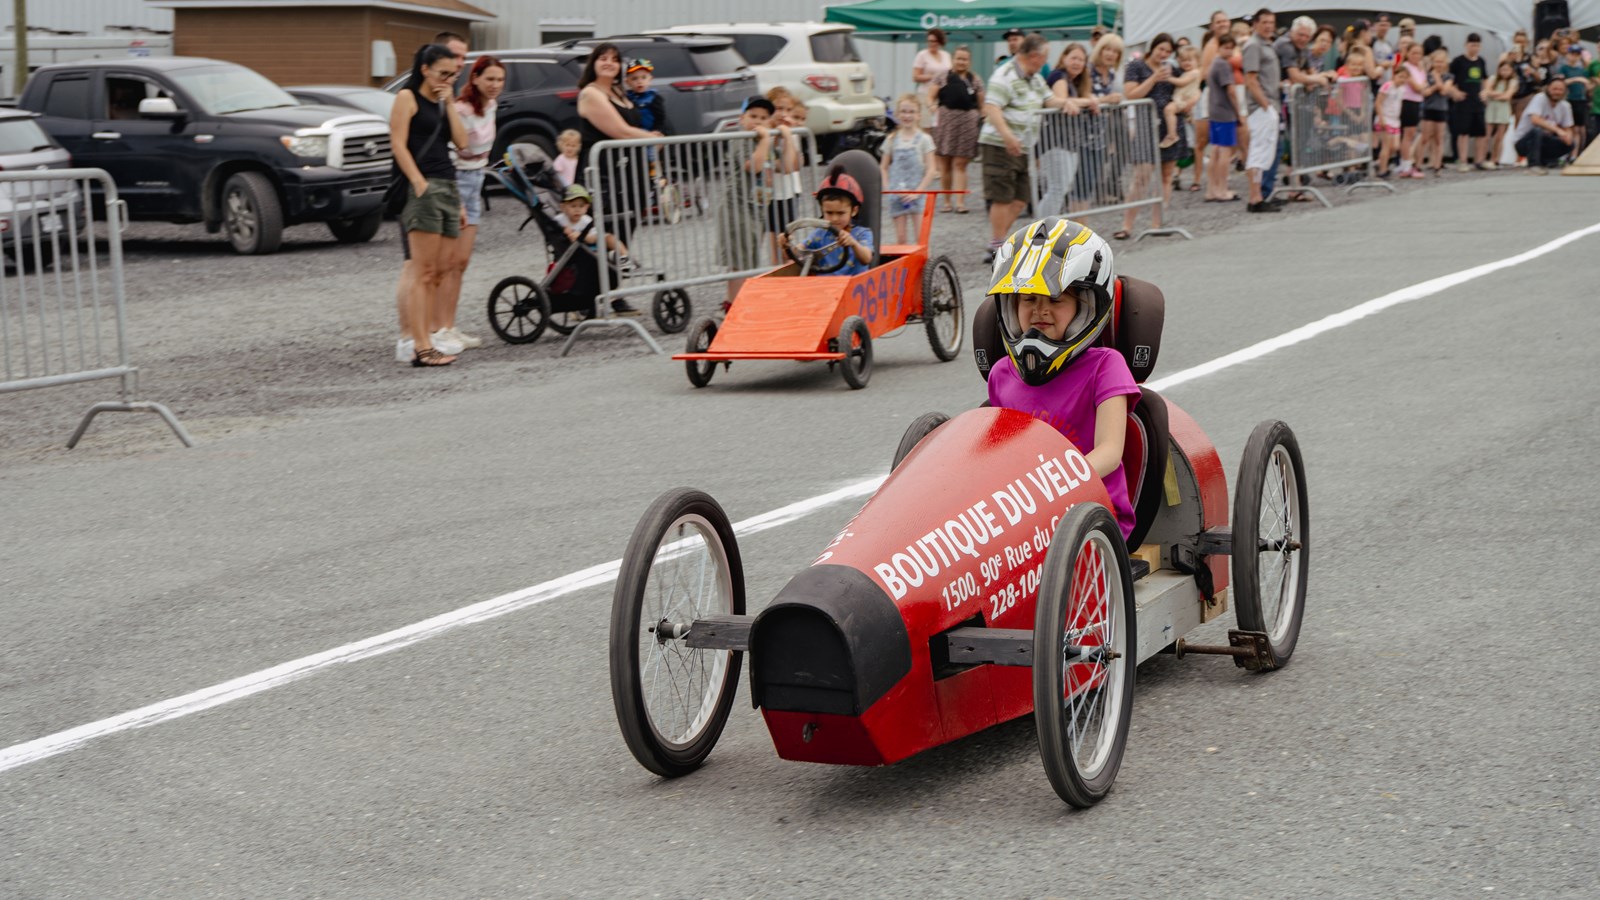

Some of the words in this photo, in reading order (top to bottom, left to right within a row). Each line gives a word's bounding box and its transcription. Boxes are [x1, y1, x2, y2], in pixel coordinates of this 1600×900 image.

[873, 500, 1004, 601] BOUTIQUE
[991, 478, 1037, 527] DU
[1026, 448, 1092, 503] VÉLO
[942, 571, 980, 611] 1500,
[1003, 541, 1032, 571] Rue
[1033, 525, 1051, 553] du
